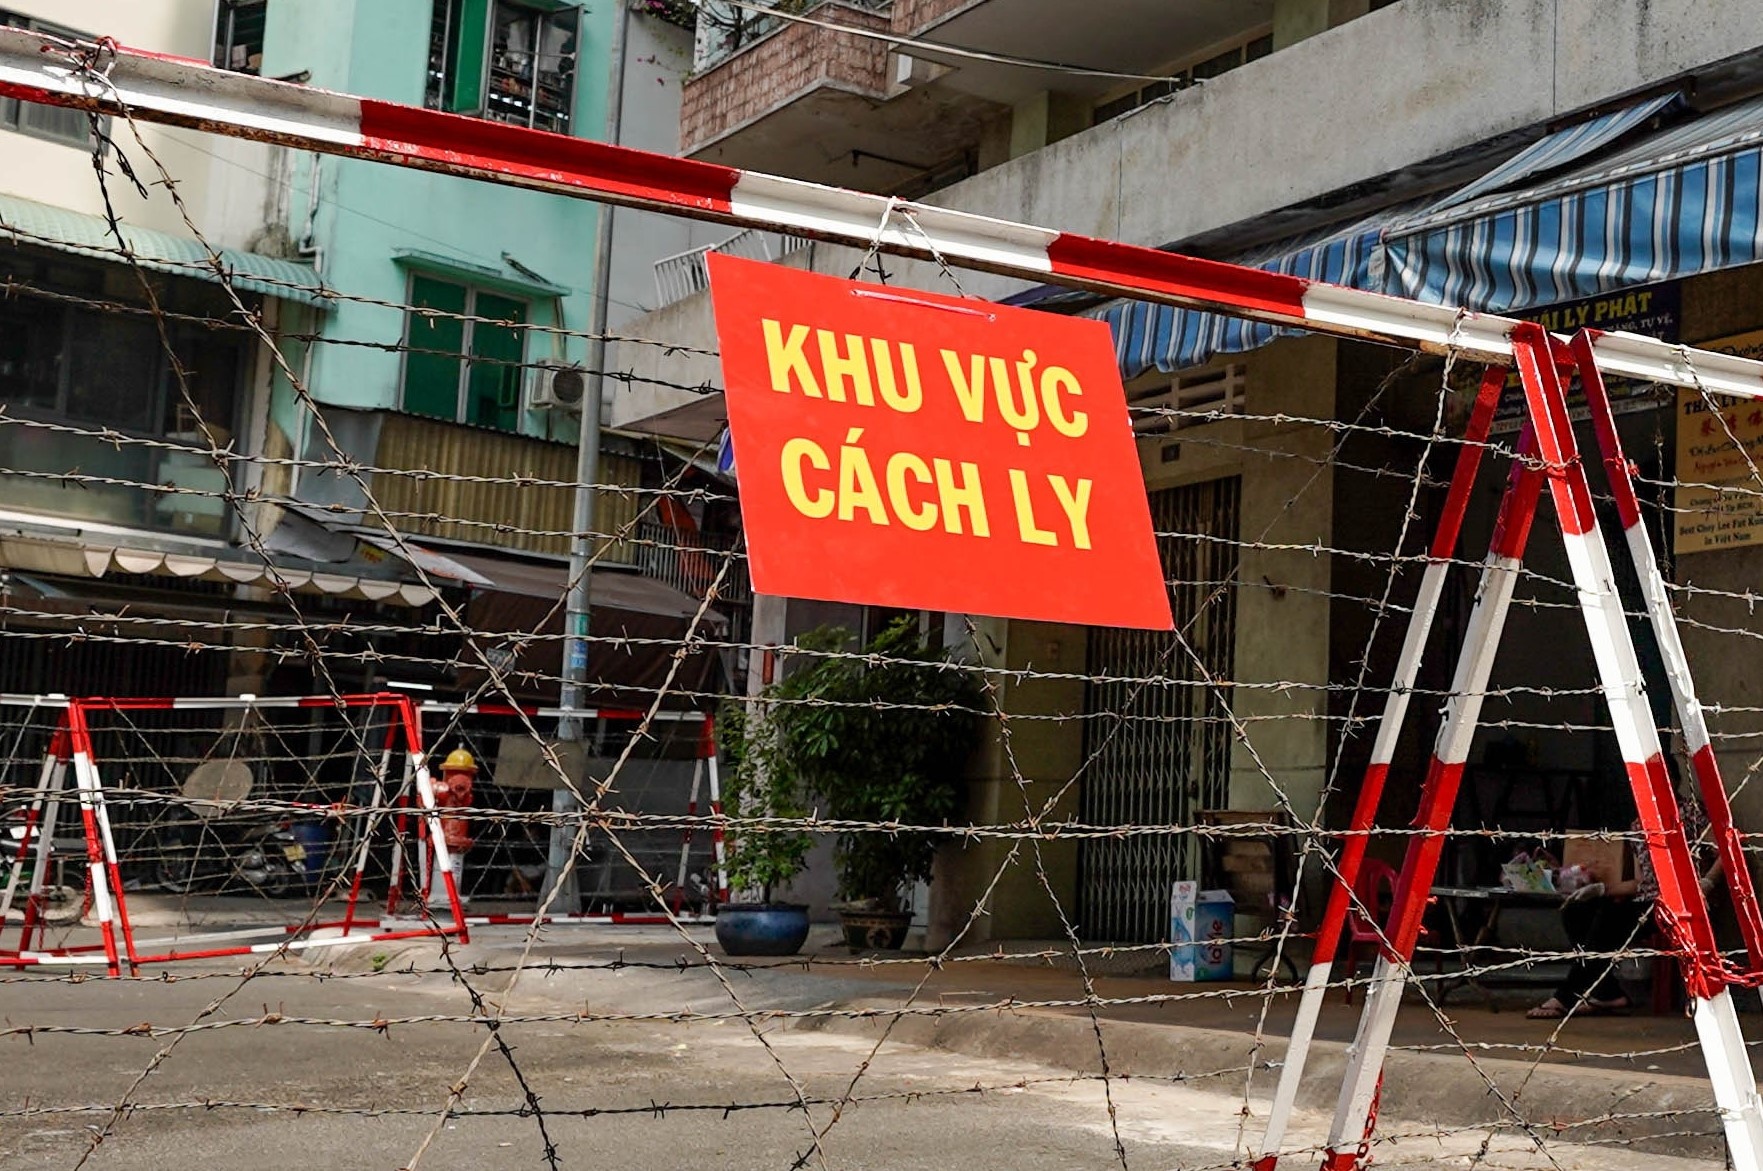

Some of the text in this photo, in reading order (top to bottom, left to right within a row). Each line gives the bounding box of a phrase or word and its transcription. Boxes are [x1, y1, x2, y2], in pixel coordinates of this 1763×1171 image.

[1563, 300, 1591, 328] LÝ
[761, 318, 1089, 448] KHU VỰC
[780, 427, 1093, 551] CÁCH LY
